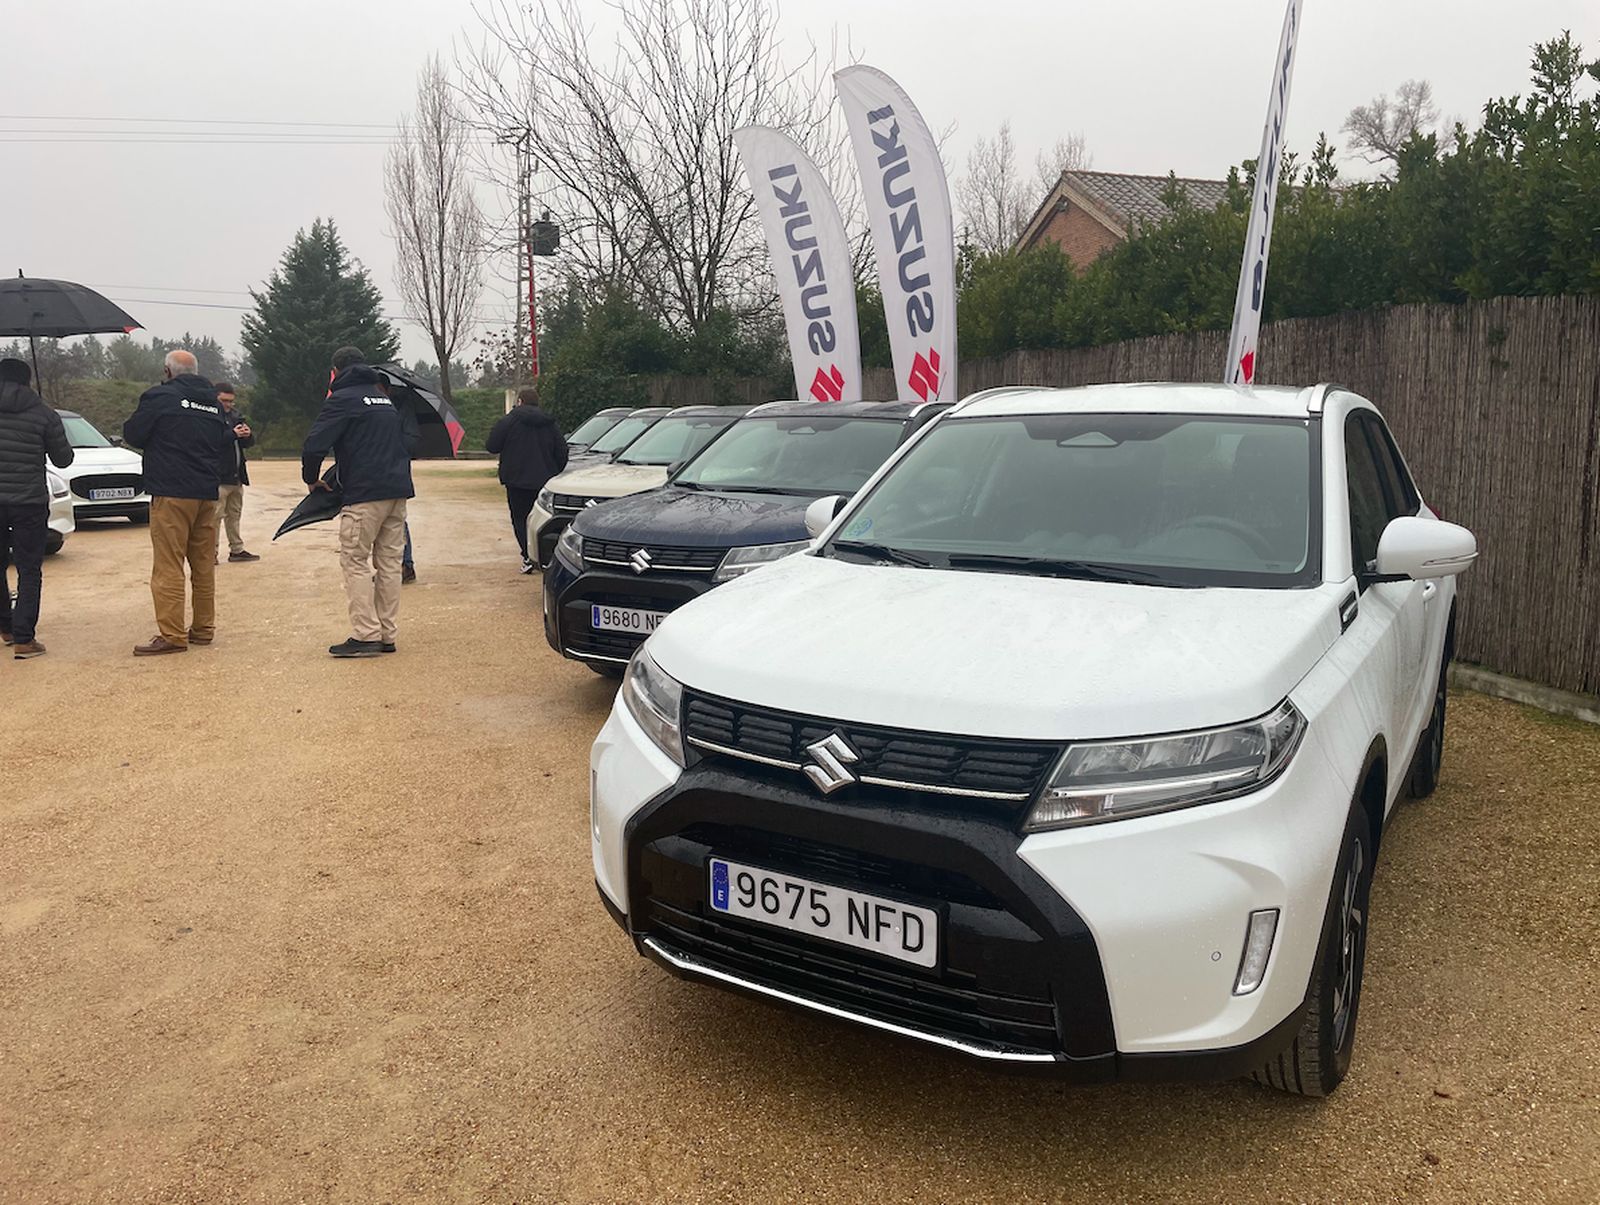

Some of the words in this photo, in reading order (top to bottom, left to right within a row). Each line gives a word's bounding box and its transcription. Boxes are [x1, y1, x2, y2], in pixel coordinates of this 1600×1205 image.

[603, 609, 640, 628] 9680
[645, 613, 664, 630] NF
[737, 872, 830, 927] 9675
[848, 897, 923, 952] NFD
